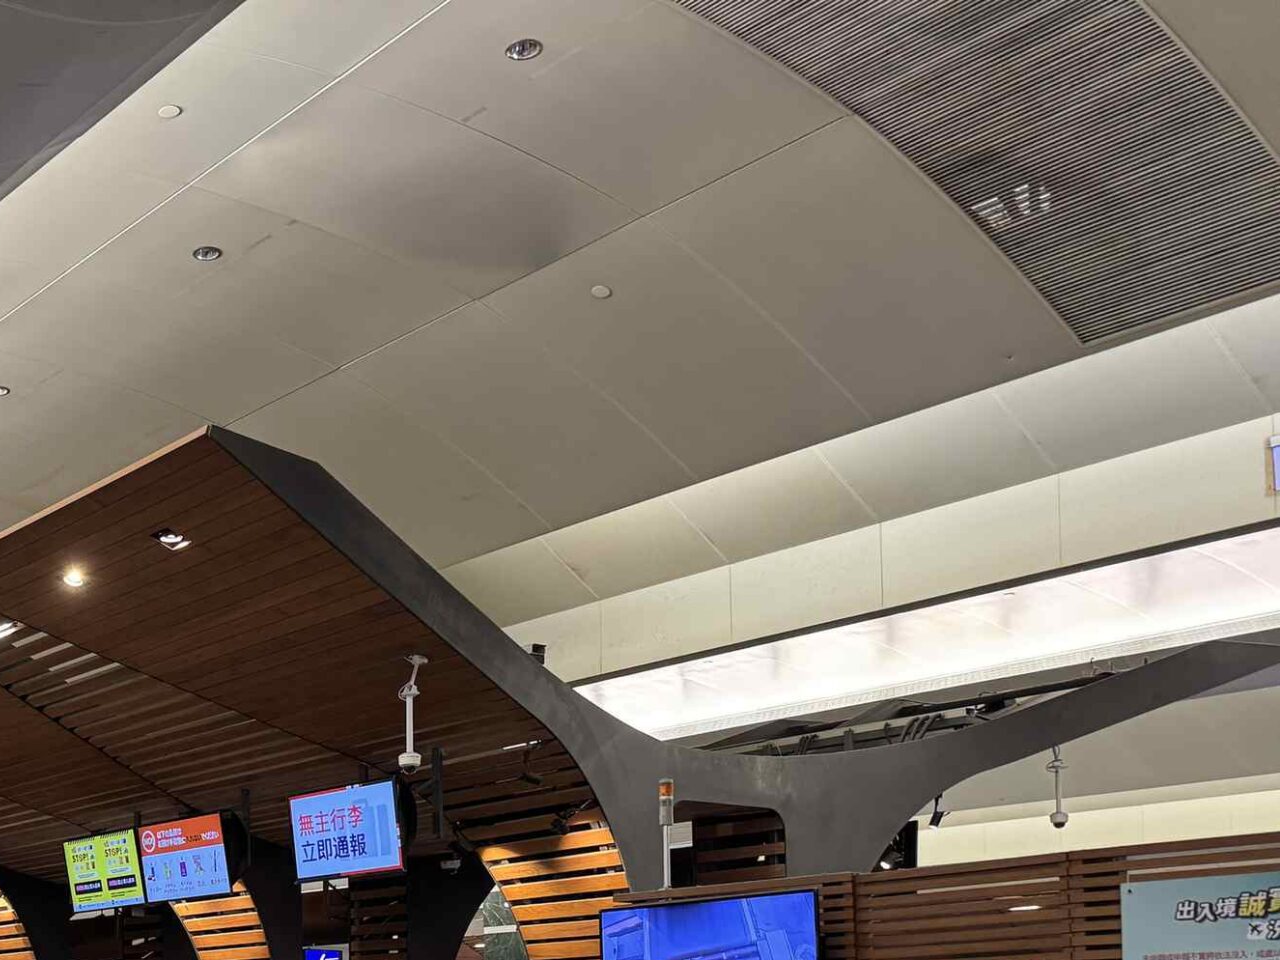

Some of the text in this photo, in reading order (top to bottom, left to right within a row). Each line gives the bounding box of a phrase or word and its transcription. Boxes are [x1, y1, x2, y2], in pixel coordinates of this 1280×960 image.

[298, 805, 364, 837] 無主行李
[301, 833, 367, 863] 立即通報
